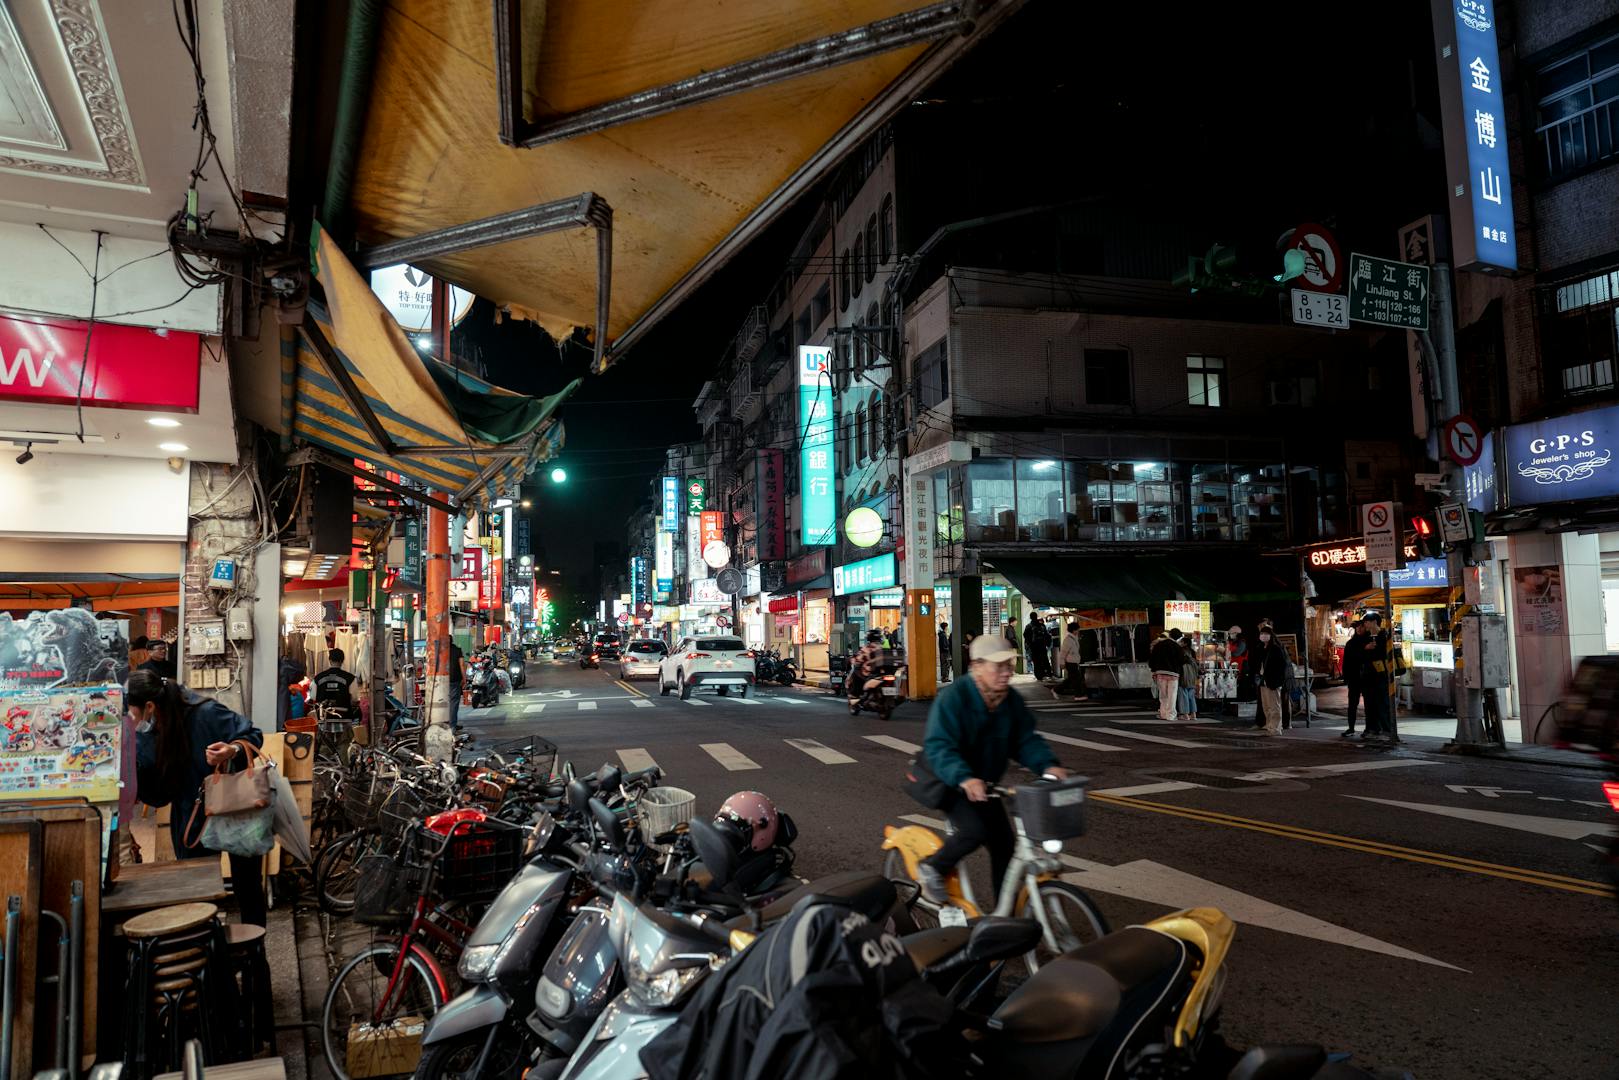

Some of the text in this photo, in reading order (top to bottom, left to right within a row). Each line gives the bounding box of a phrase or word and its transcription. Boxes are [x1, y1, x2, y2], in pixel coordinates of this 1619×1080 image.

[1470, 57, 1502, 205] 金博山
[1407, 231, 1428, 260] 金
[1358, 259, 1421, 288] 臨江街
[1366, 283, 1414, 301] LinJiang St.
[1326, 297, 1342, 311] 12
[1298, 308, 1313, 321] 18
[1327, 311, 1343, 325] 24
[1531, 448, 1596, 466] Jeweler's shop
